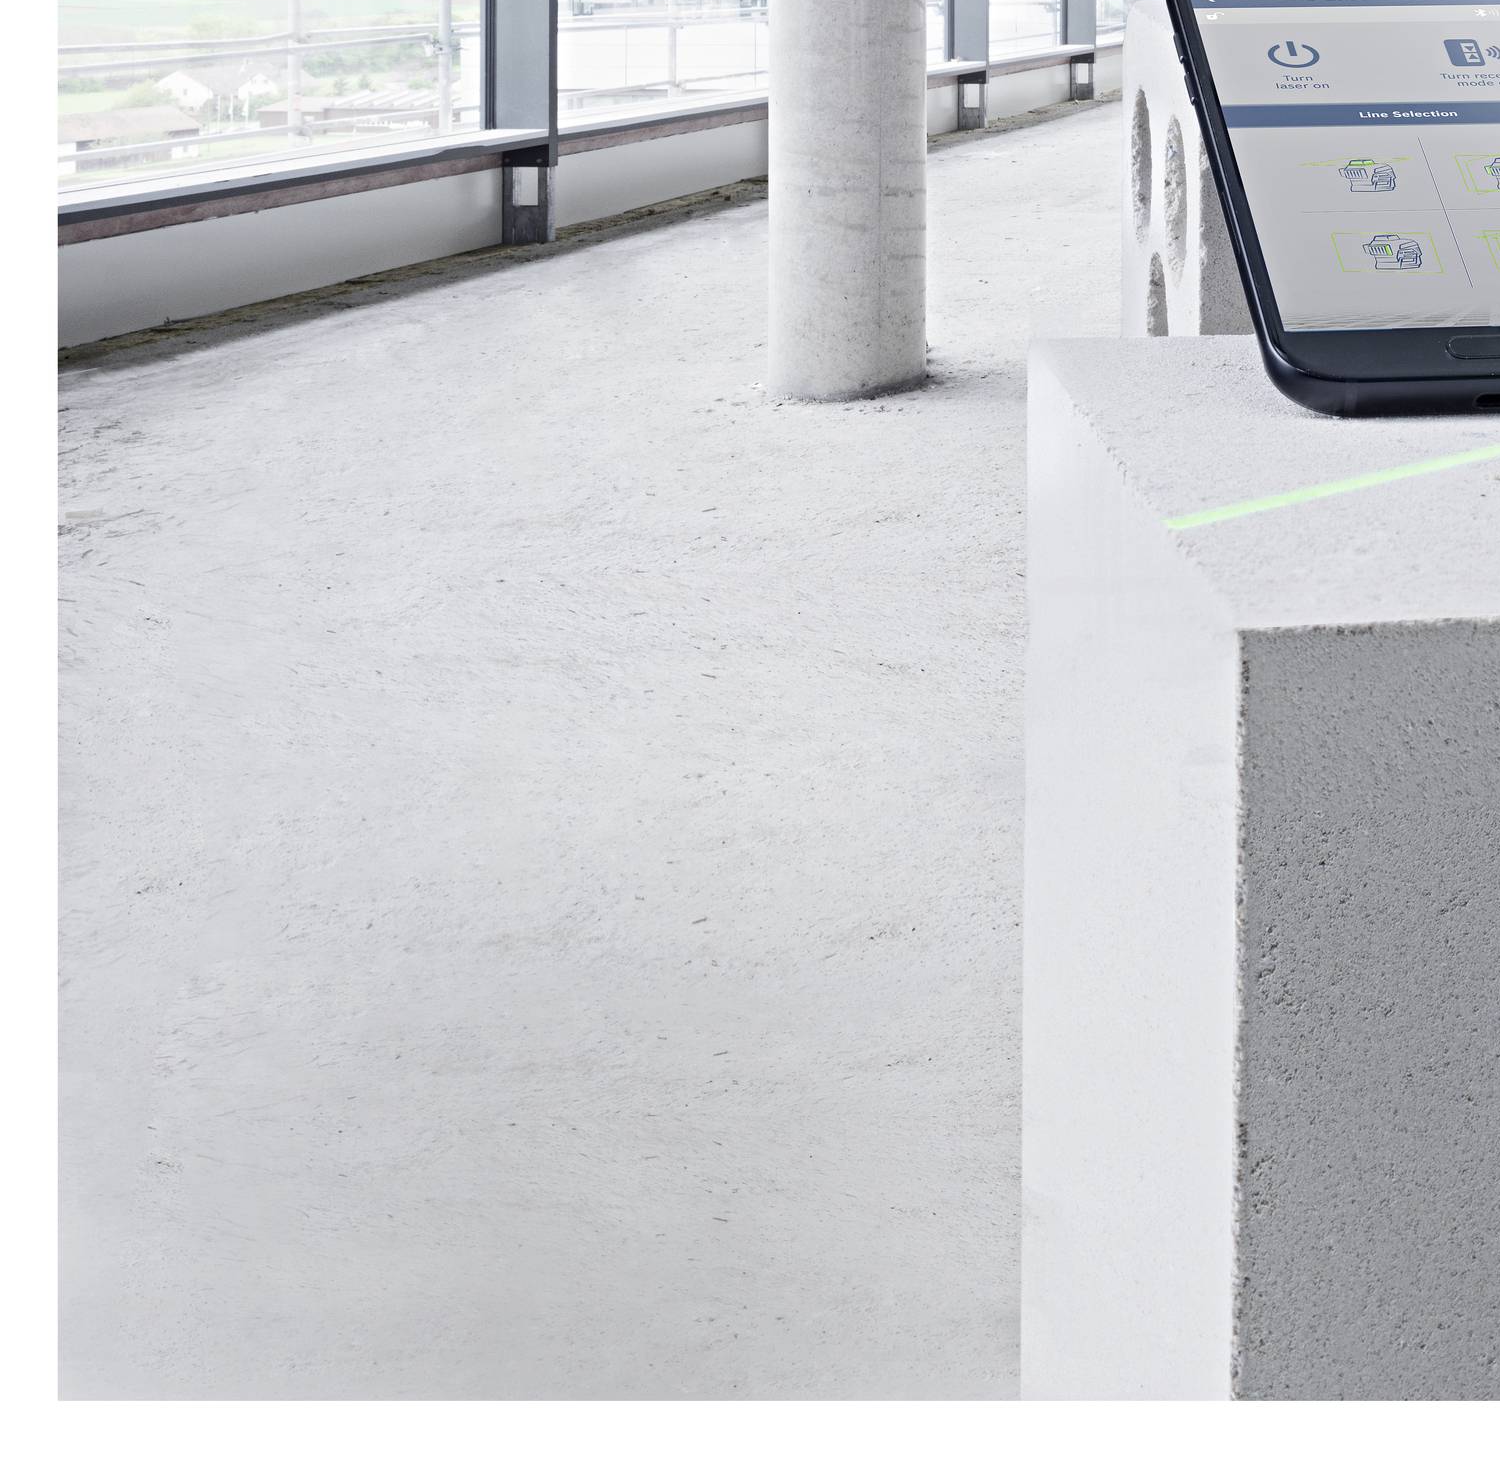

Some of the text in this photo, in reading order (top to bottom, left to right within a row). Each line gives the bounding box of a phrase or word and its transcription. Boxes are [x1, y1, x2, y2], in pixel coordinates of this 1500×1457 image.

[1440, 72, 1470, 80] Turn
[1275, 82, 1308, 90] laser
[1457, 79, 1494, 87] mode
[1359, 110, 1458, 119] Line Selection
